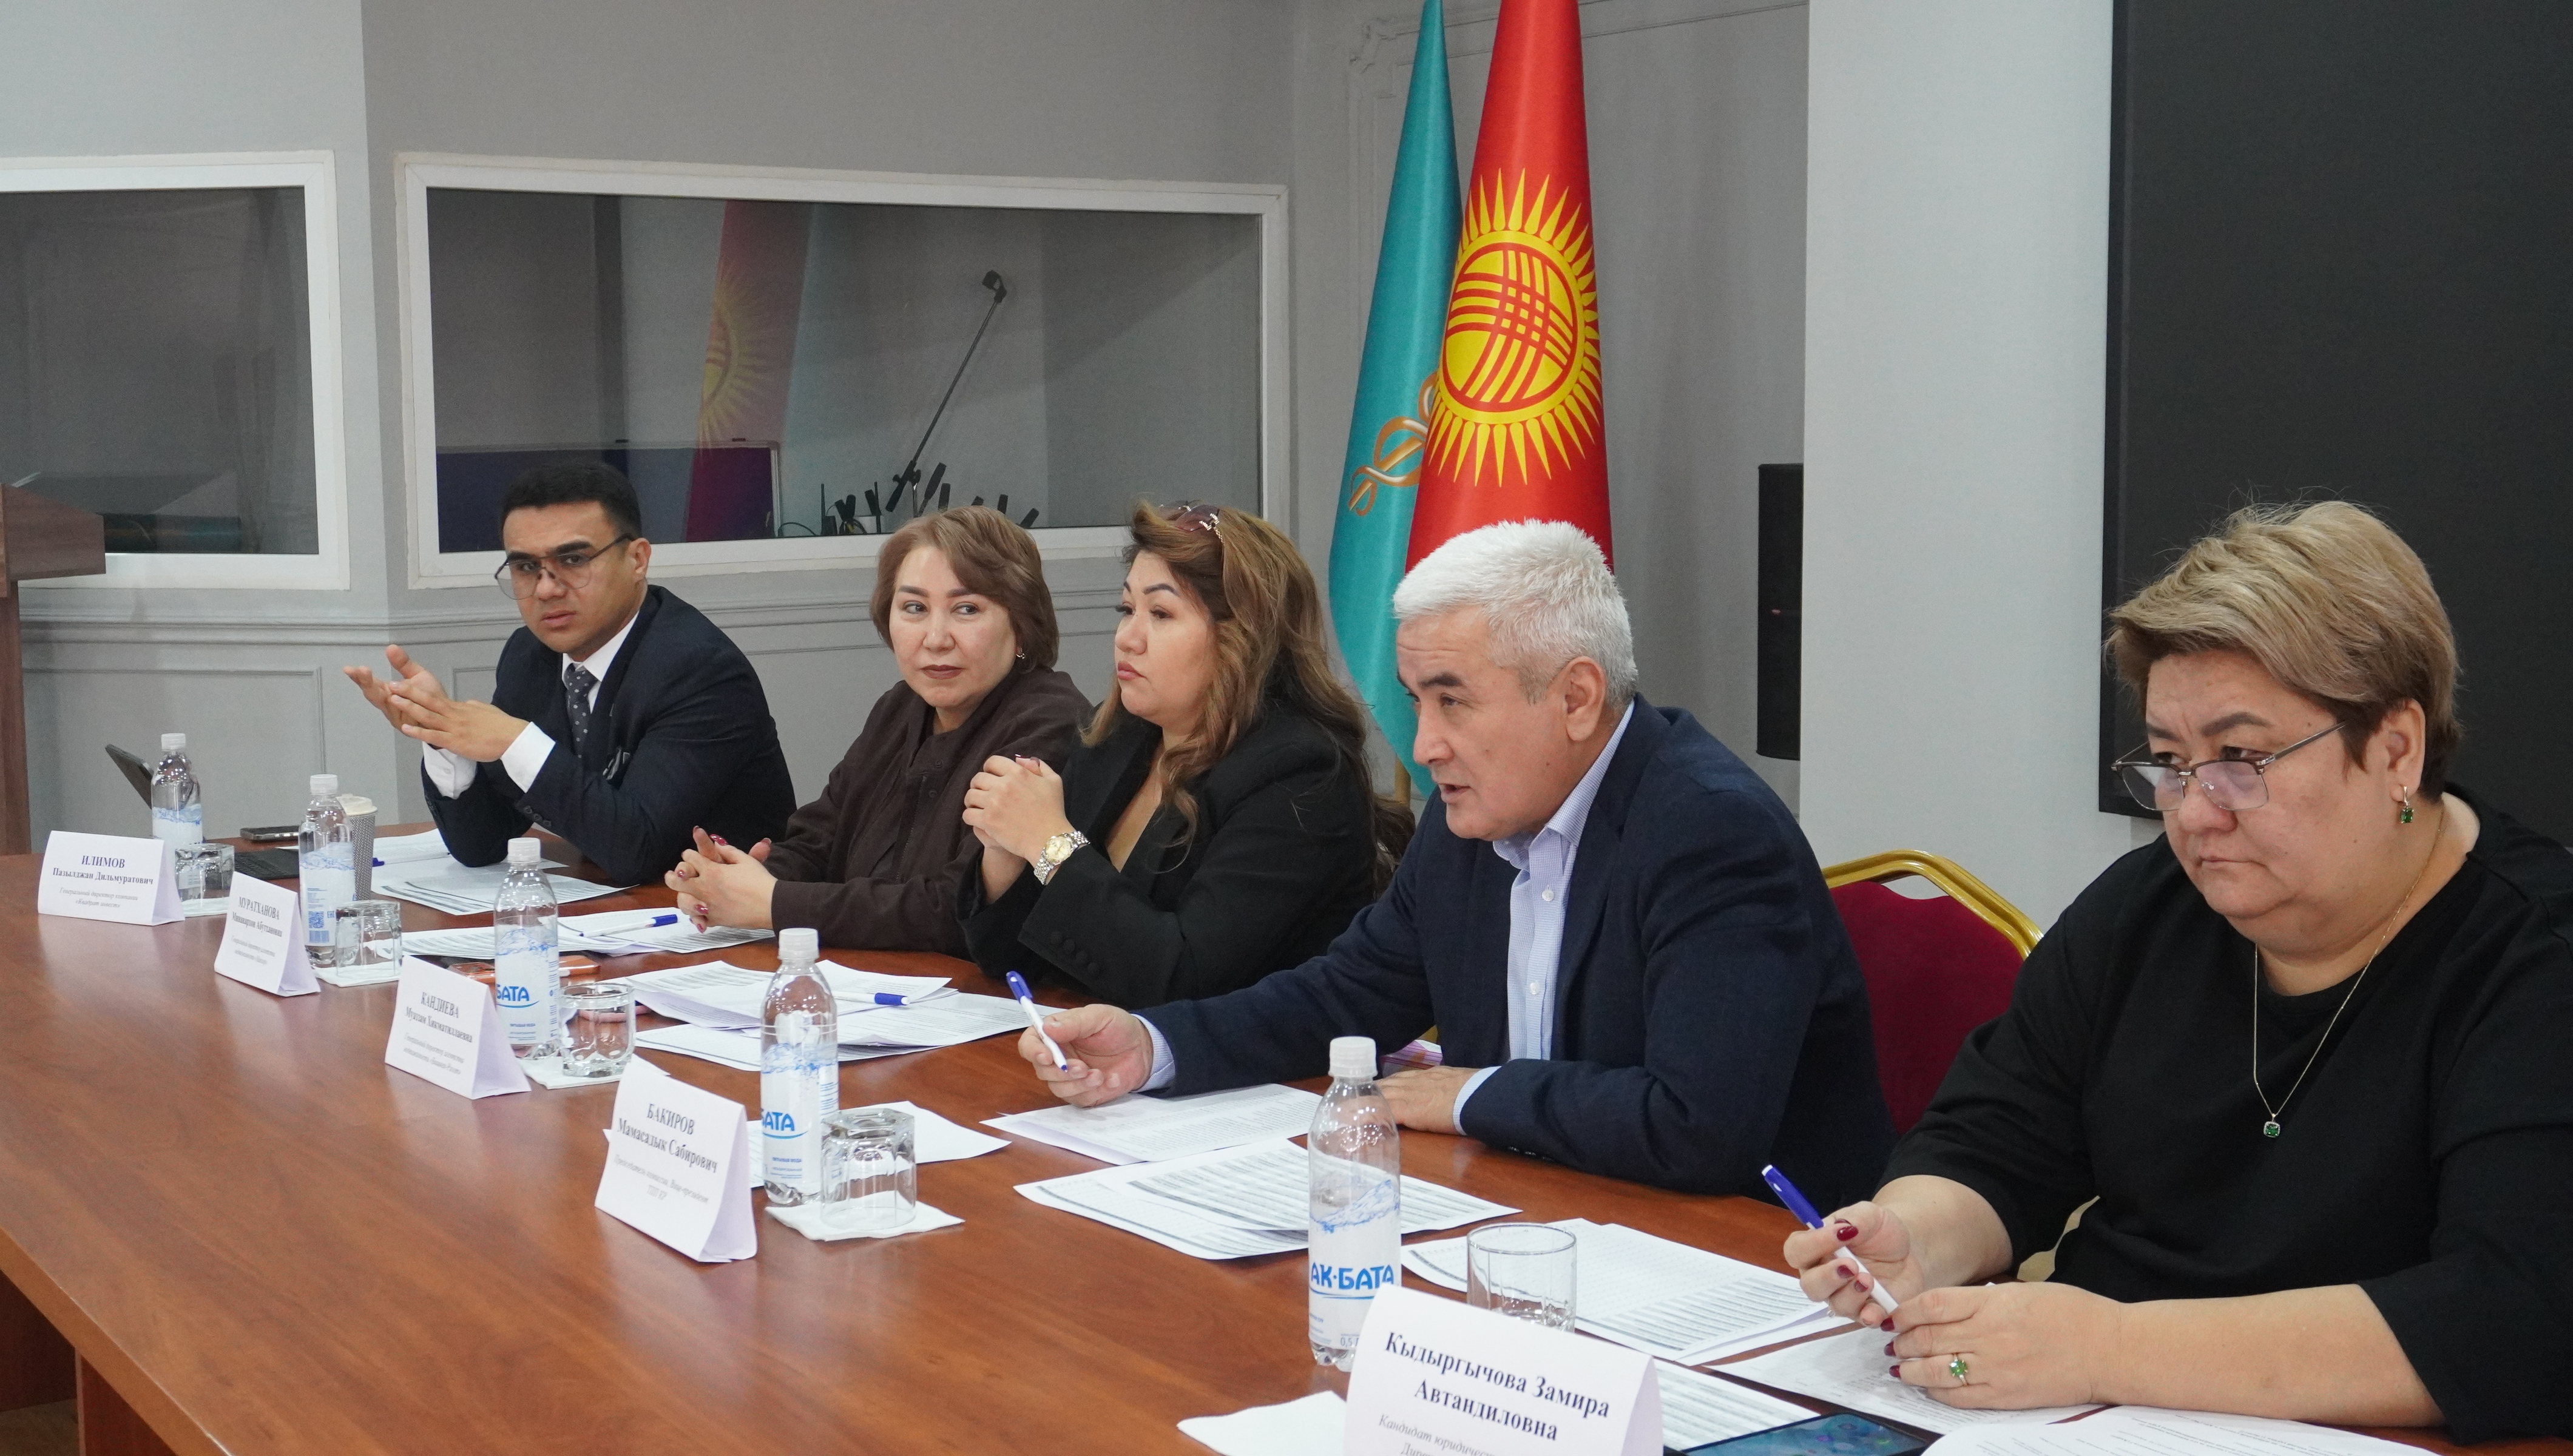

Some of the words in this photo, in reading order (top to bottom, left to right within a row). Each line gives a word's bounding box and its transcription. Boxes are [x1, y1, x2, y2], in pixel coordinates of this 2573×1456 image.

[81, 855, 126, 868] ИЛИМОВ
[53, 868, 93, 879] Пазылджан
[95, 871, 154, 885] Дильмуратович
[238, 896, 280, 920] МУРАТХАНОВА
[421, 991, 459, 1019] КАНДИЕВА
[646, 1103, 695, 1135] БАКИРОВ
[762, 1108, 796, 1131] АТА
[617, 1117, 668, 1151] Мамасадык
[669, 1139, 718, 1173] Сабирович
[1384, 1332, 1527, 1393] Кыдыргычова
[1532, 1376, 1610, 1420] Замира
[1414, 1379, 1558, 1441] Автандиловна
[1378, 1414, 1432, 1442] Кандидат
